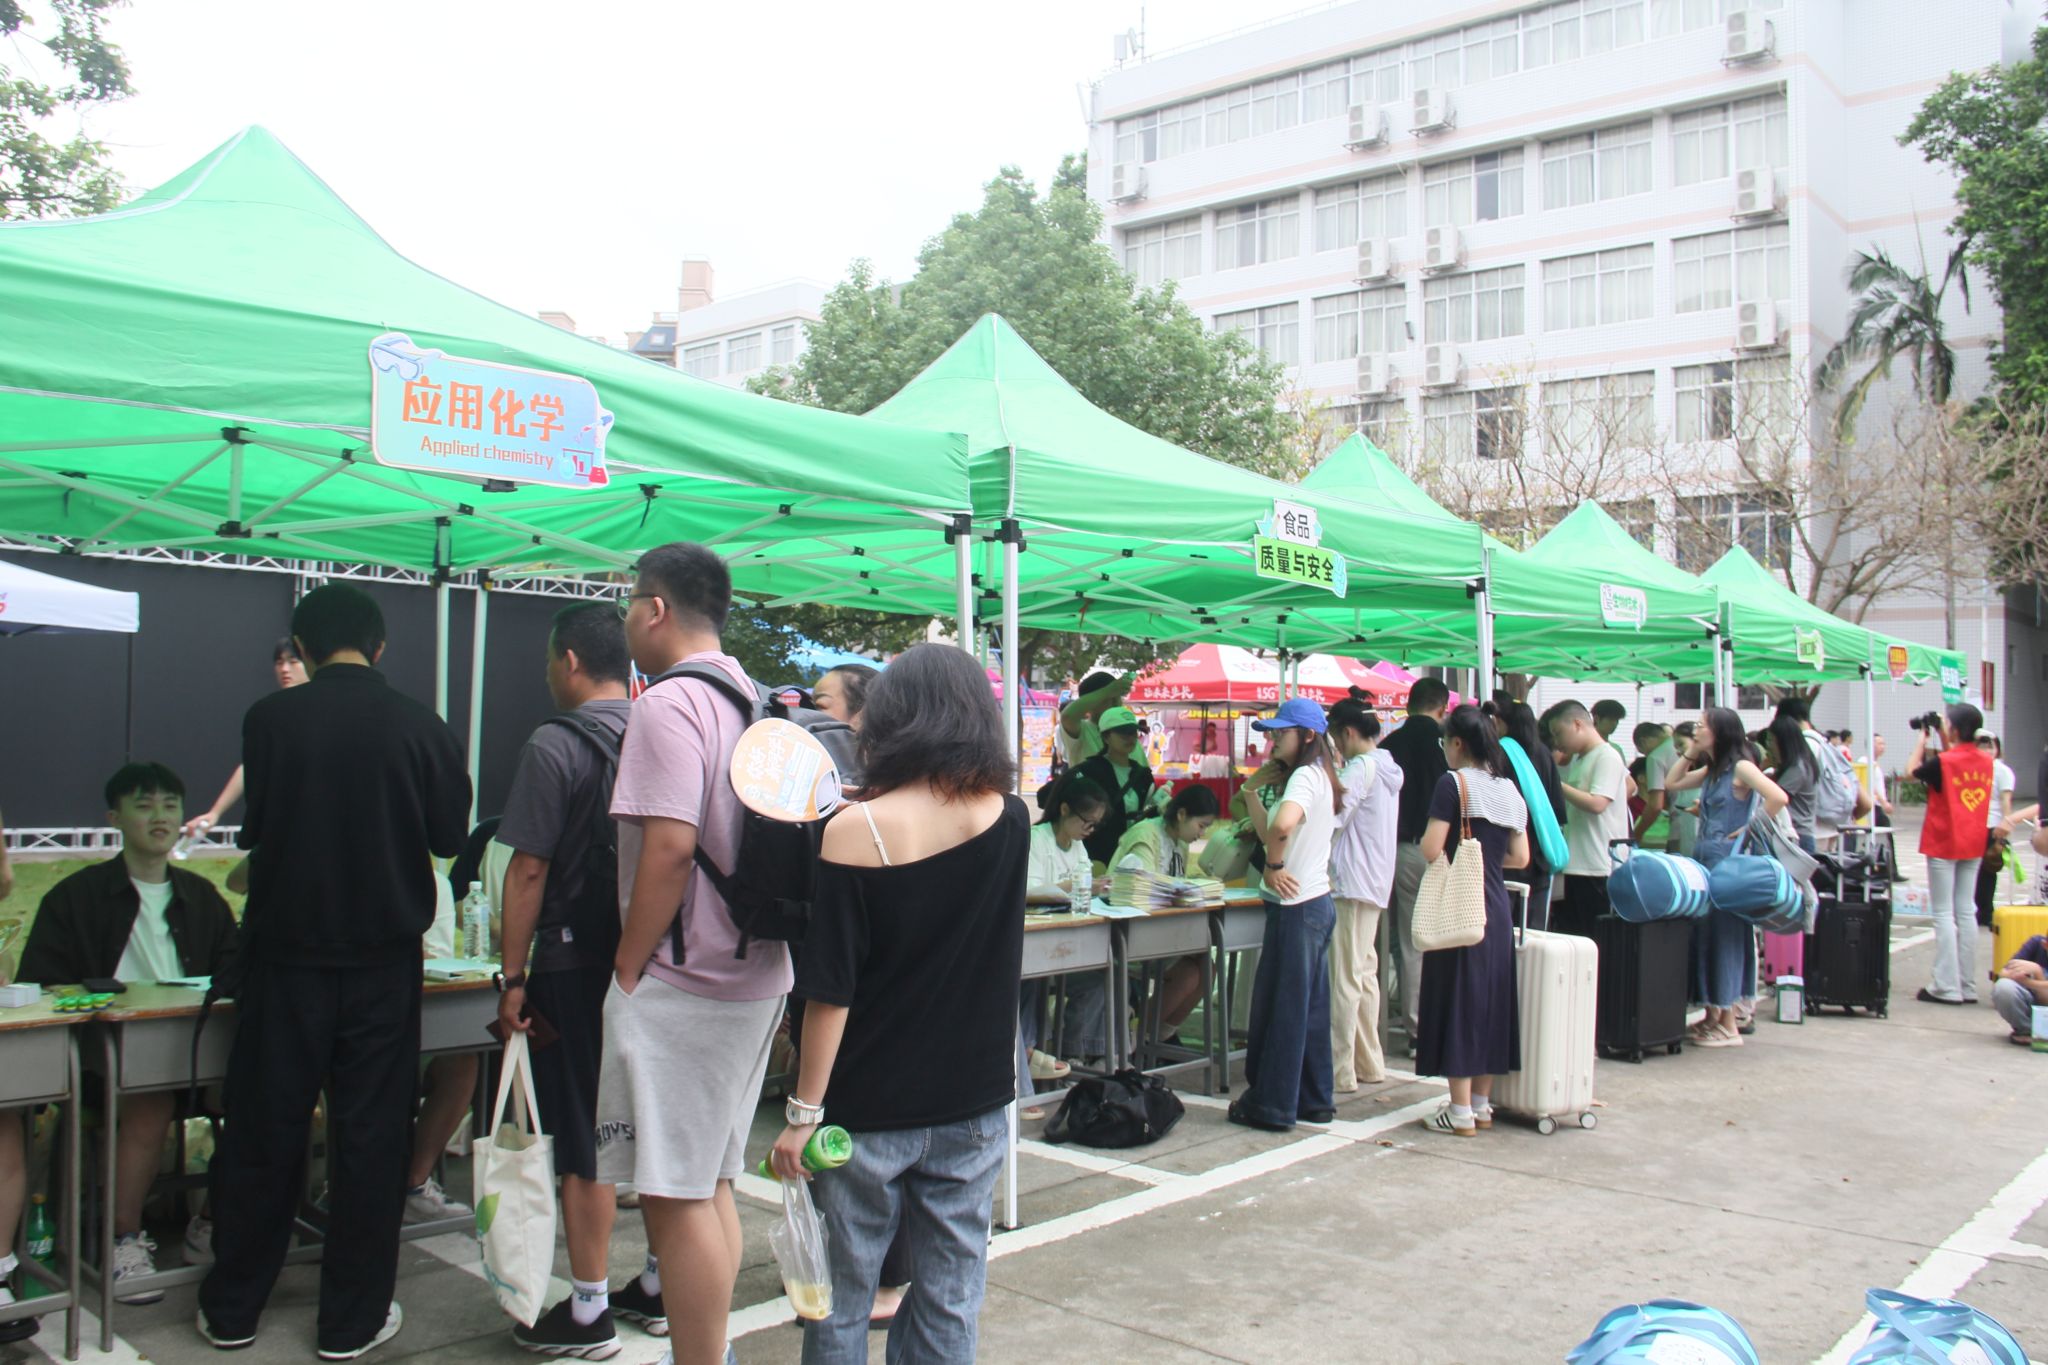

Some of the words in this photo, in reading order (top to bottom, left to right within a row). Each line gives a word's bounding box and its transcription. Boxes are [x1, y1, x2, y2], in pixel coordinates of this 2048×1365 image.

[402, 375, 564, 442] 应用化学
[420, 435, 479, 458] Applied
[484, 445, 554, 469] chemistry
[1283, 510, 1310, 539] 食品
[1260, 545, 1334, 582] 质量与安全
